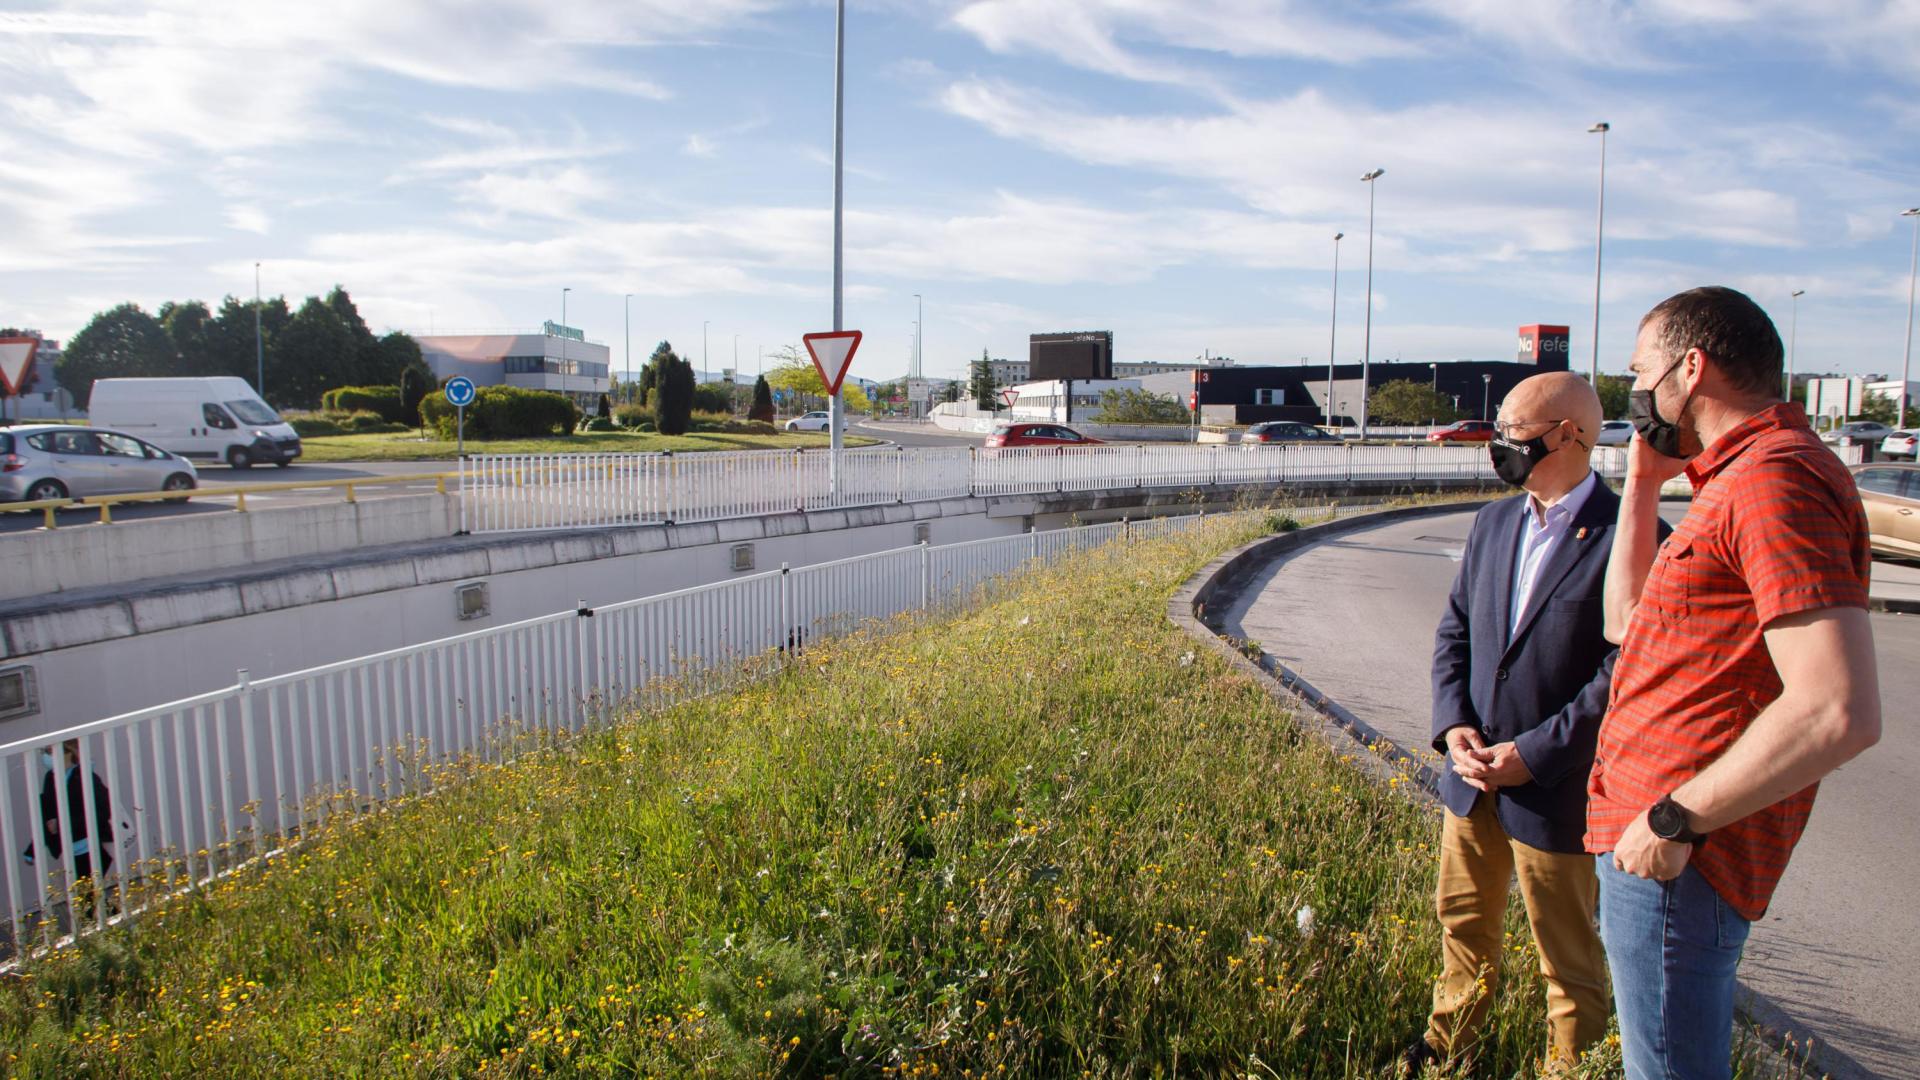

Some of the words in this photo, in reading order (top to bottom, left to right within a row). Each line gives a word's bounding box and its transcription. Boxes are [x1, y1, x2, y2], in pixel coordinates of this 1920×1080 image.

[1519, 337, 1533, 352] Na
[1539, 336, 1569, 352] refe
[1202, 372, 1209, 382] 3
